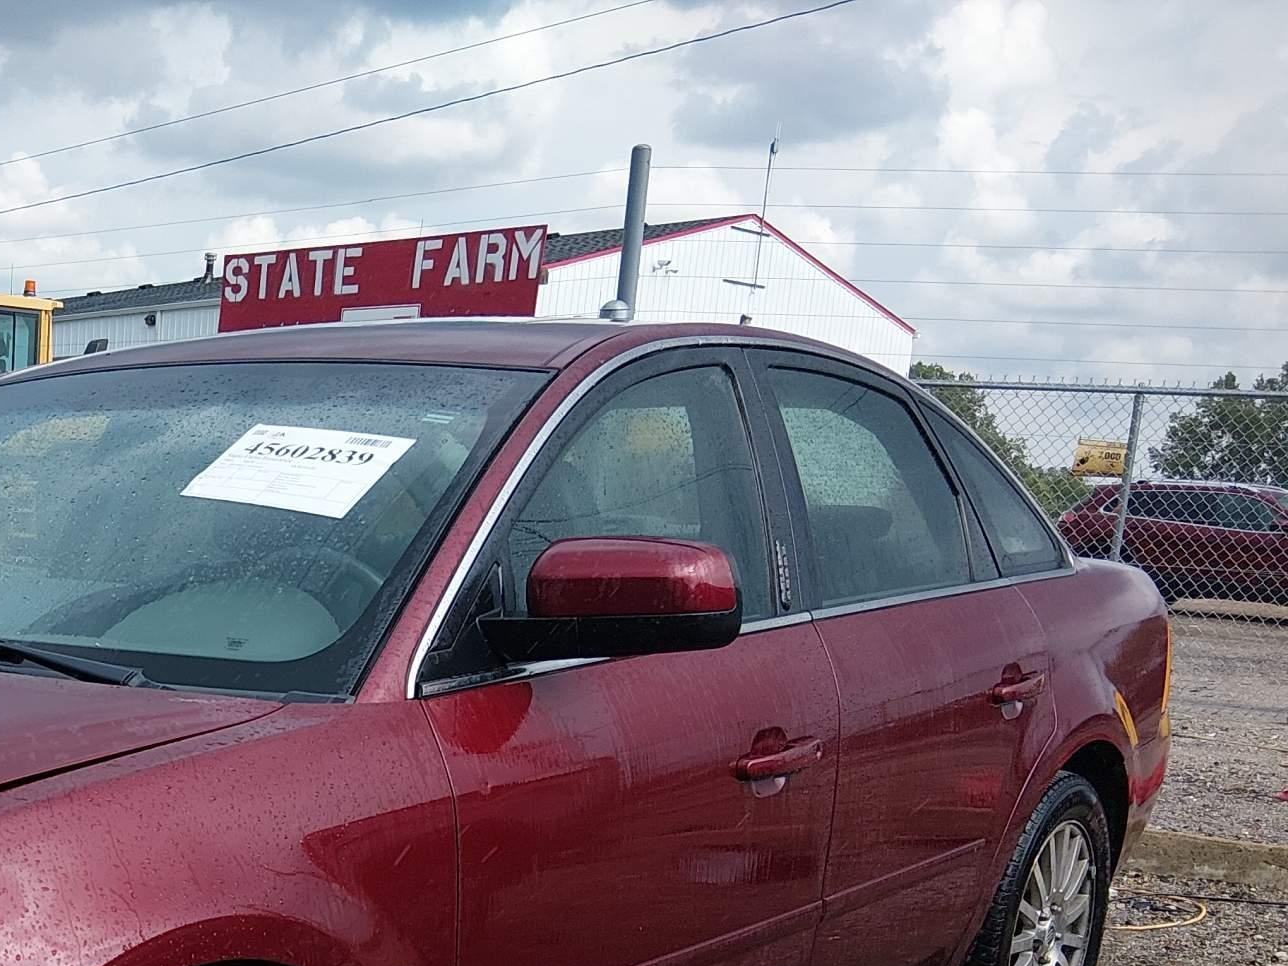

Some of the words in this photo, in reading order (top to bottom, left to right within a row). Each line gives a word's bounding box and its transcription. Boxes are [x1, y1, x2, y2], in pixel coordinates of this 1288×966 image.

[223, 246, 363, 303] STATE
[411, 227, 545, 290] FARM
[244, 441, 375, 466] 45602839
